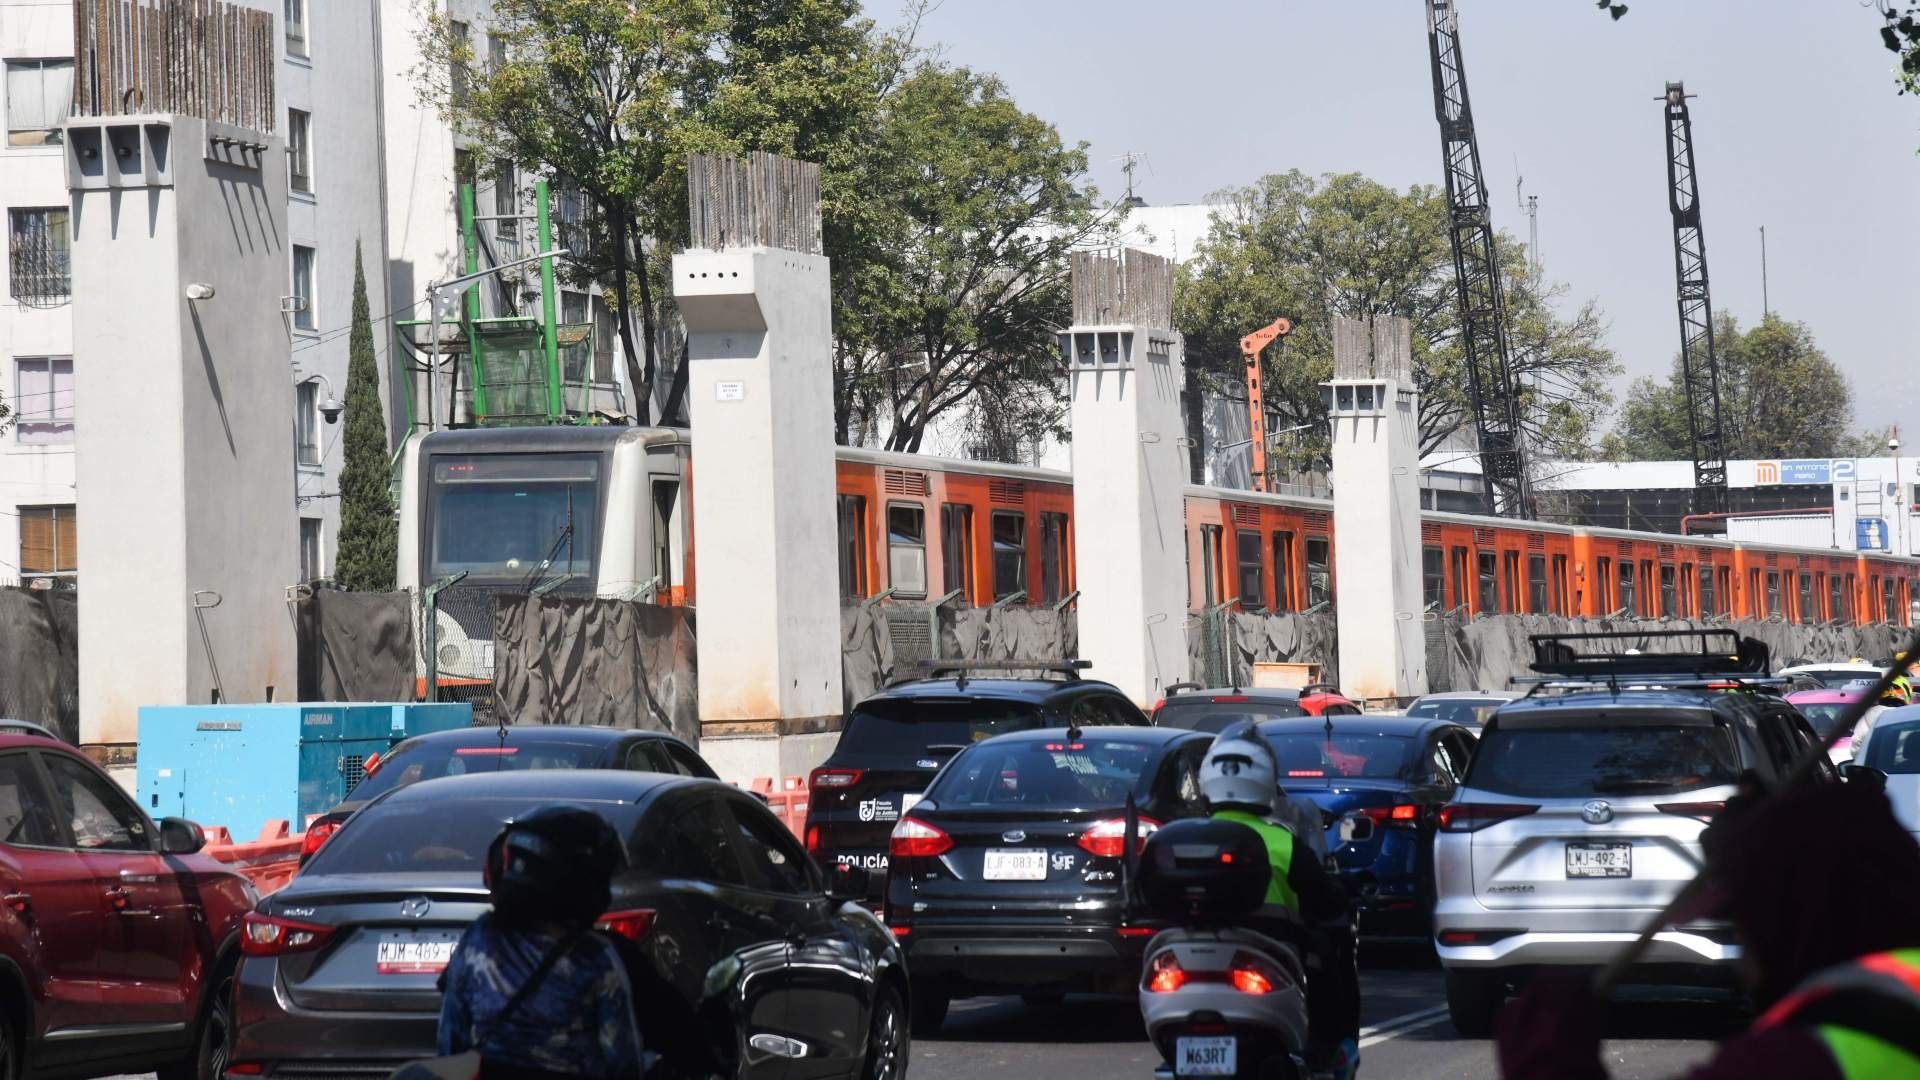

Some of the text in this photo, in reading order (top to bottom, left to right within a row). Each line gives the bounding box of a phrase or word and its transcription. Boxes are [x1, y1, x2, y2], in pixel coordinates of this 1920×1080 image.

[1833, 460, 1855, 481] 2
[304, 713, 333, 726] AIRMAN
[837, 853, 889, 869] POLICÍA
[1568, 851, 1629, 866] LMJ-492-A
